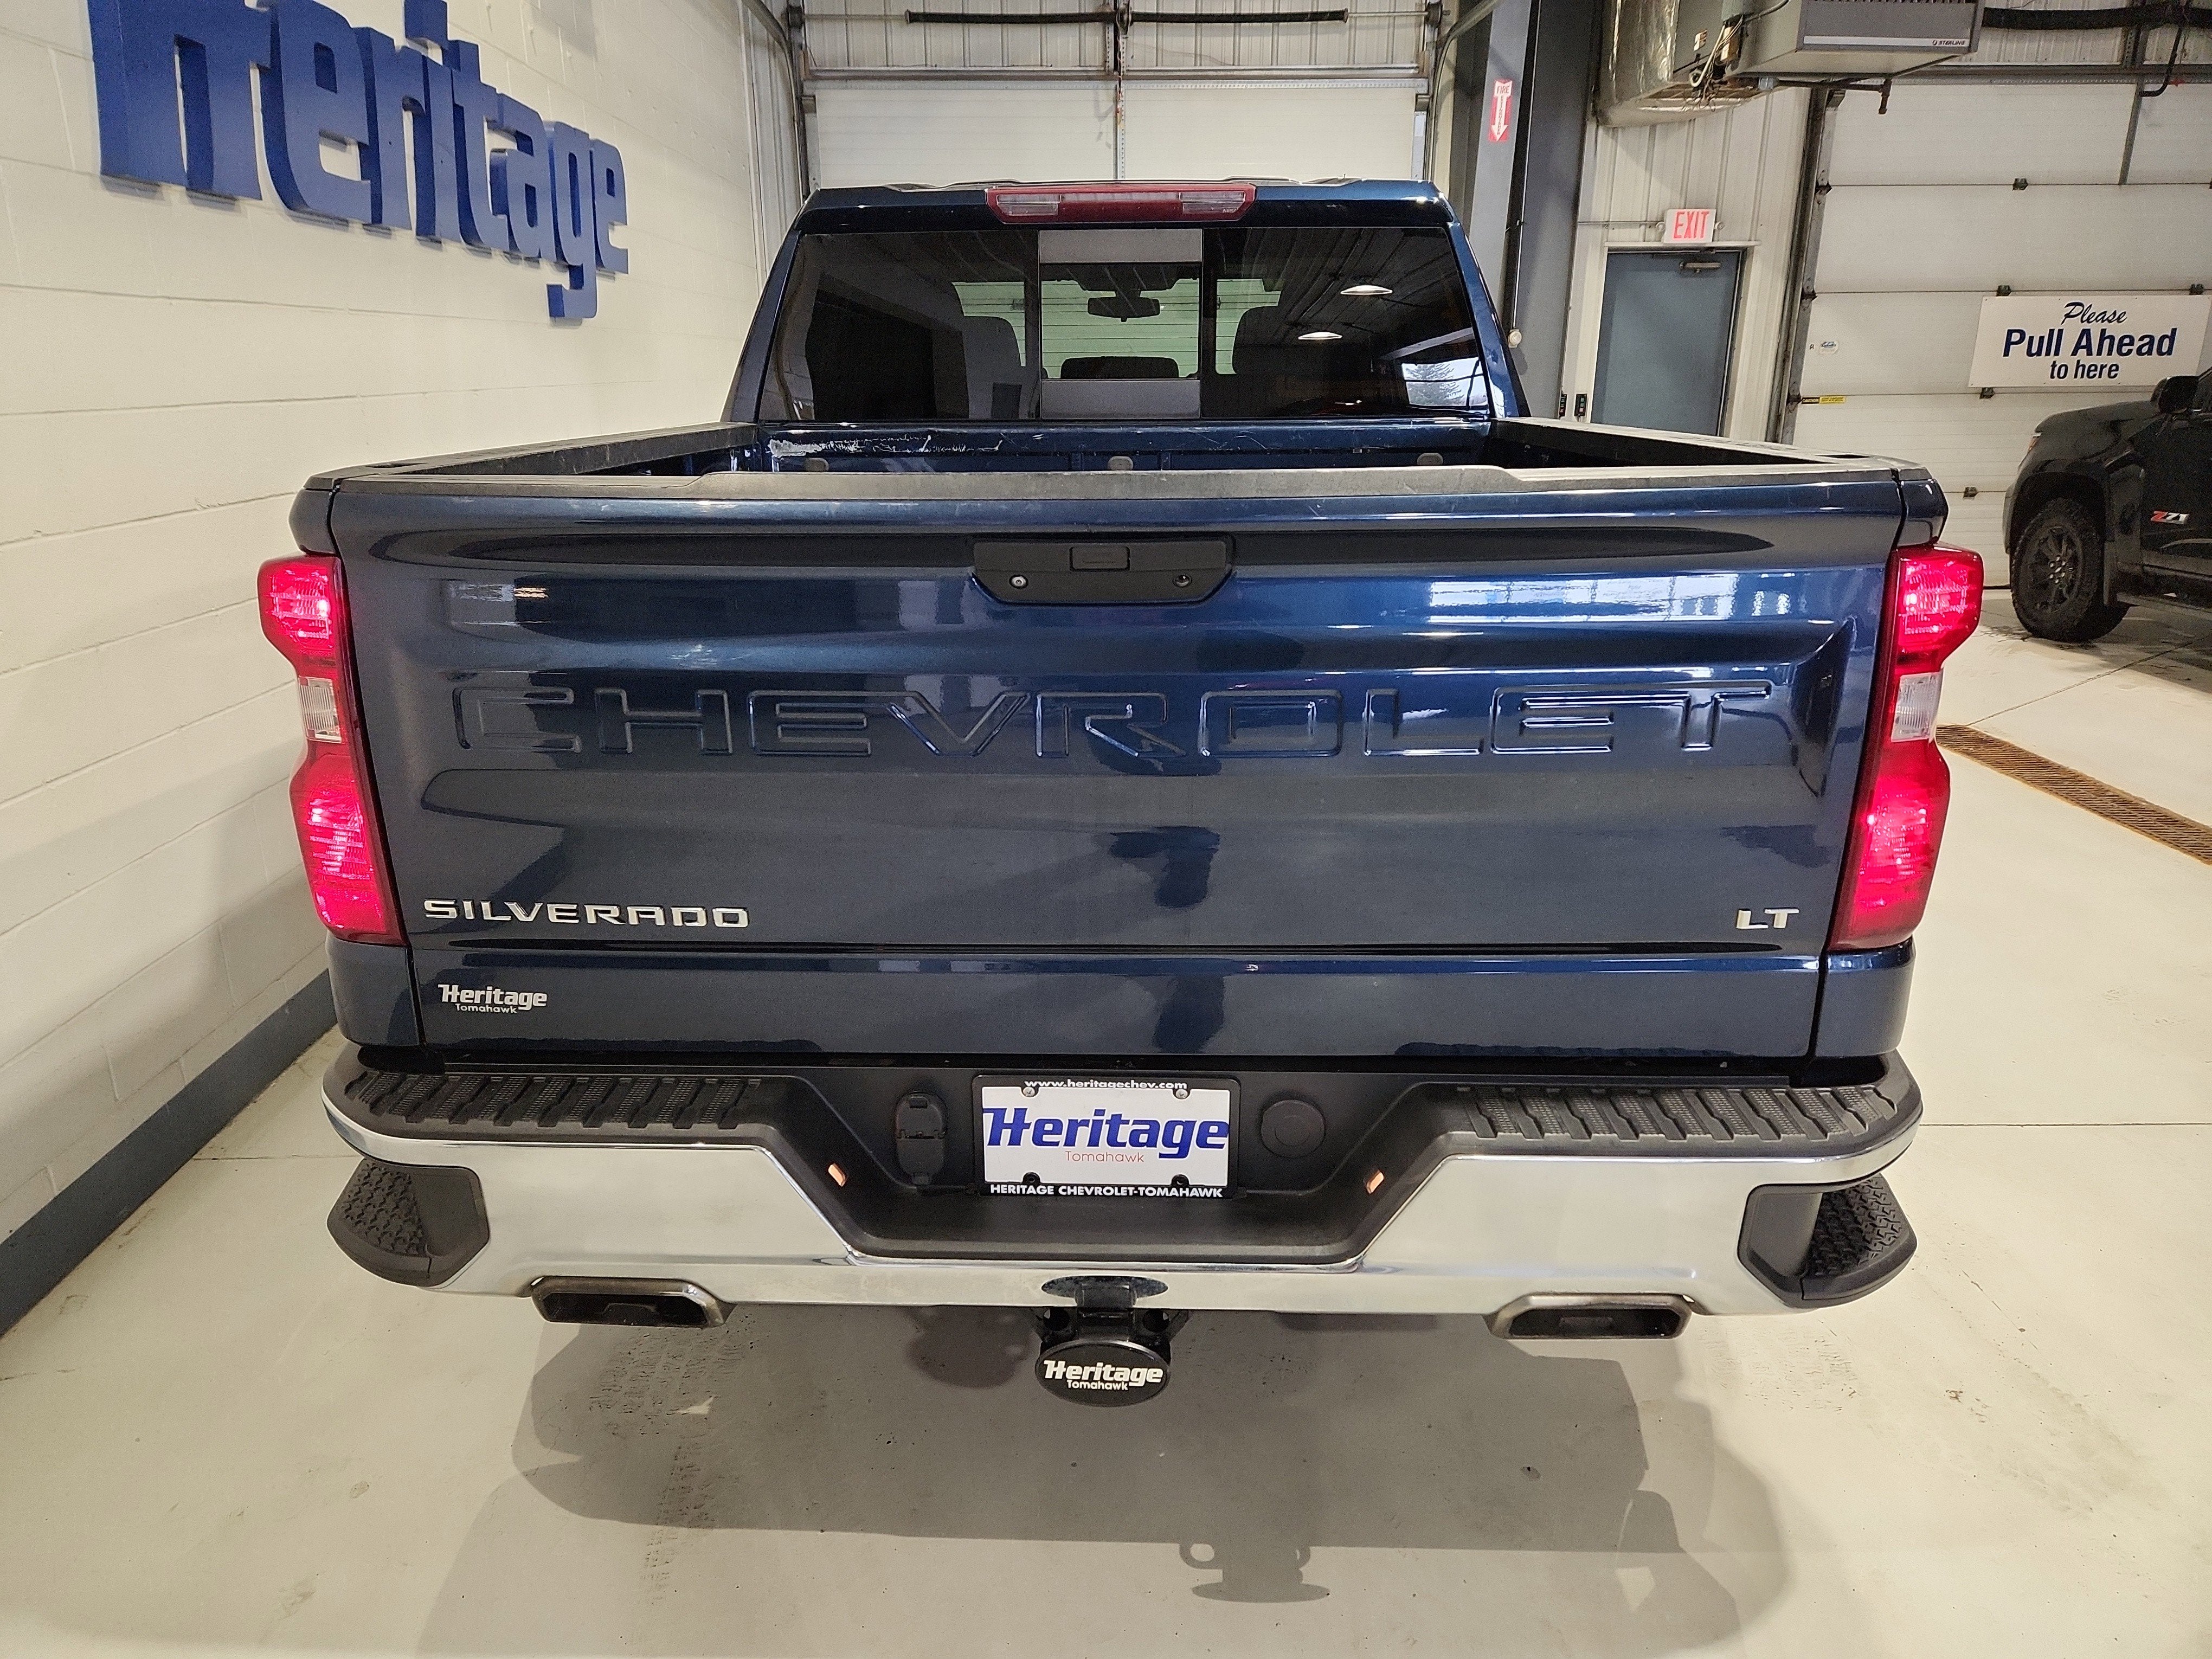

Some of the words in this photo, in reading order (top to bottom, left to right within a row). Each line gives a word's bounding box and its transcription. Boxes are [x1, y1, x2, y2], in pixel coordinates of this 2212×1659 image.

[1496, 86, 1510, 94] FIRE
[1673, 211, 1709, 239] EXIT
[2061, 301, 2127, 325] Please
[2003, 329, 2064, 357] Pull
[2070, 327, 2178, 357] Ahead
[2050, 360, 2068, 379] to
[2074, 359, 2119, 379] here
[2151, 511, 2189, 524] Z71
[452, 679, 1773, 756] CHEVROLET
[423, 899, 749, 928] SILVERADO
[1737, 908, 1799, 929] LT
[438, 984, 548, 1010] Heritage
[455, 1003, 517, 1014] Tomahawk
[1025, 1079, 1187, 1090] www.heritagechev.com
[982, 1108, 1230, 1159] Heritage
[1065, 1150, 1144, 1163] Tomahawk
[991, 1184, 1054, 1195] HERITAGE
[1058, 1186, 1223, 1198] CHEVROLET-TOMAHAWK
[1043, 1360, 1163, 1387] Heritage
[1066, 1379, 1128, 1391] Tomahawk
